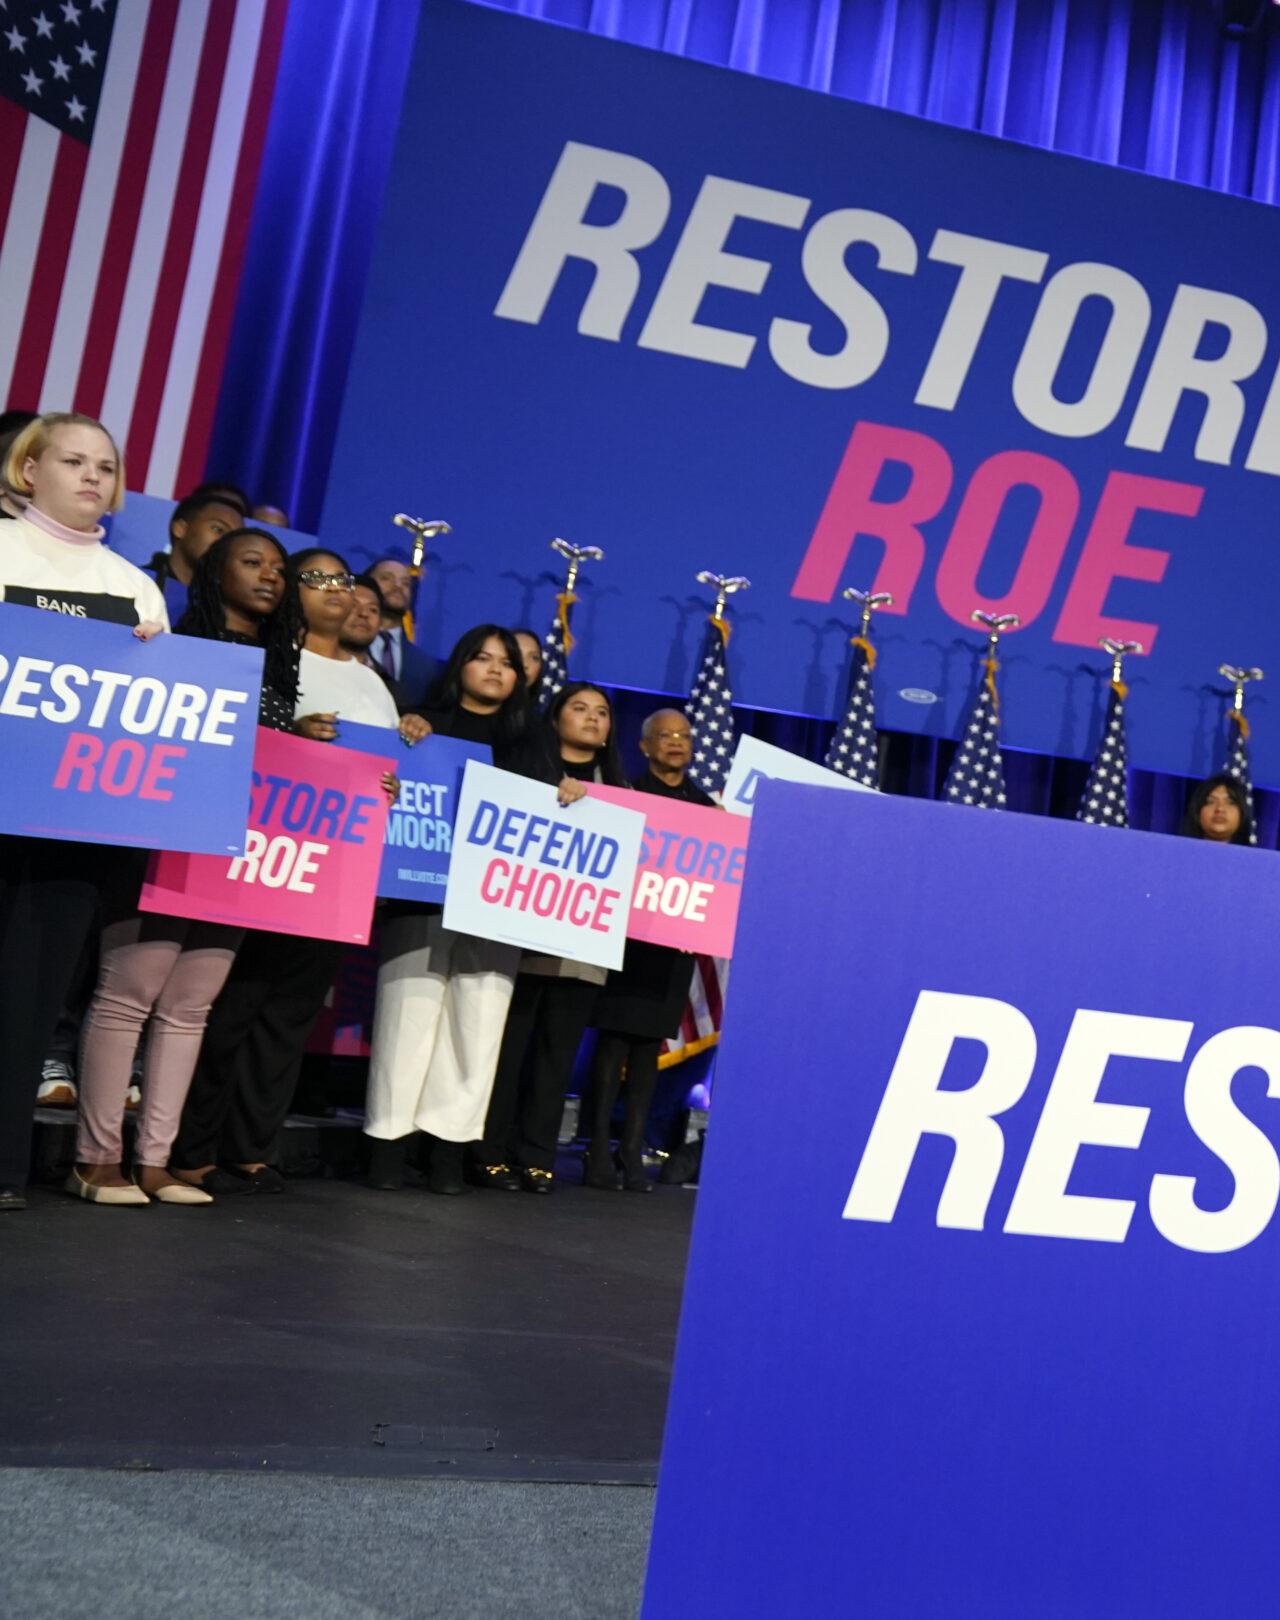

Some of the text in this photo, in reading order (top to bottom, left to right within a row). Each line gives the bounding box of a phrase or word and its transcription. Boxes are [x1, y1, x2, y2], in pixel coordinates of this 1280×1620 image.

[791, 421, 1204, 656] ROE
[36, 594, 87, 618] BANS
[53, 732, 187, 801] ROE
[227, 829, 330, 894] ROE
[383, 812, 452, 853] MOCR
[466, 800, 619, 880] DEFEND
[637, 826, 747, 885] STORE
[481, 858, 621, 932] CHOICE
[633, 870, 715, 922] ROE
